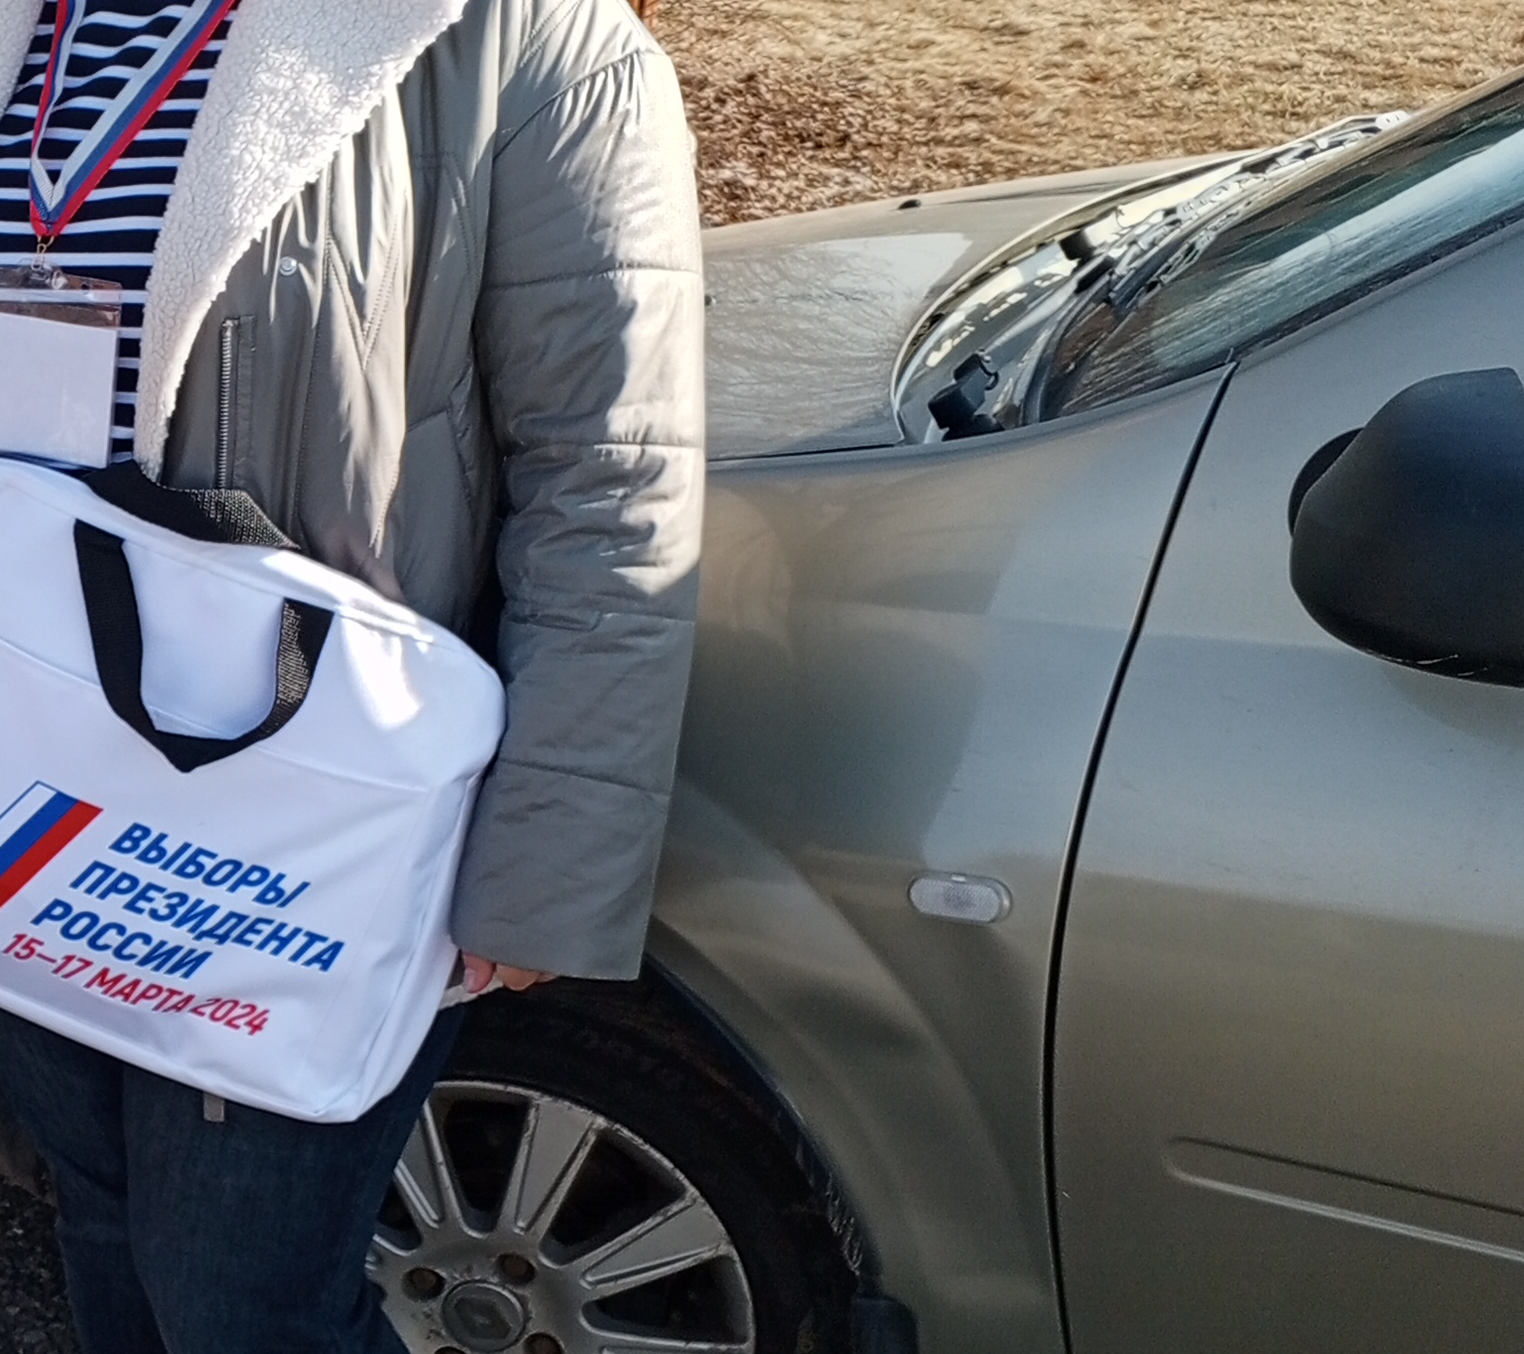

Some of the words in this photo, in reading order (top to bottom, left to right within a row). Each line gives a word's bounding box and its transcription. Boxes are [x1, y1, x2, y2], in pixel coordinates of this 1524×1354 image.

[108, 822, 311, 909] ВЫБОРЫ
[30, 898, 214, 980] РОССИИ
[70, 860, 345, 973] ПРЕЗИДЕНТА
[82, 967, 196, 1013] МАРТА
[188, 997, 271, 1036] 2024
